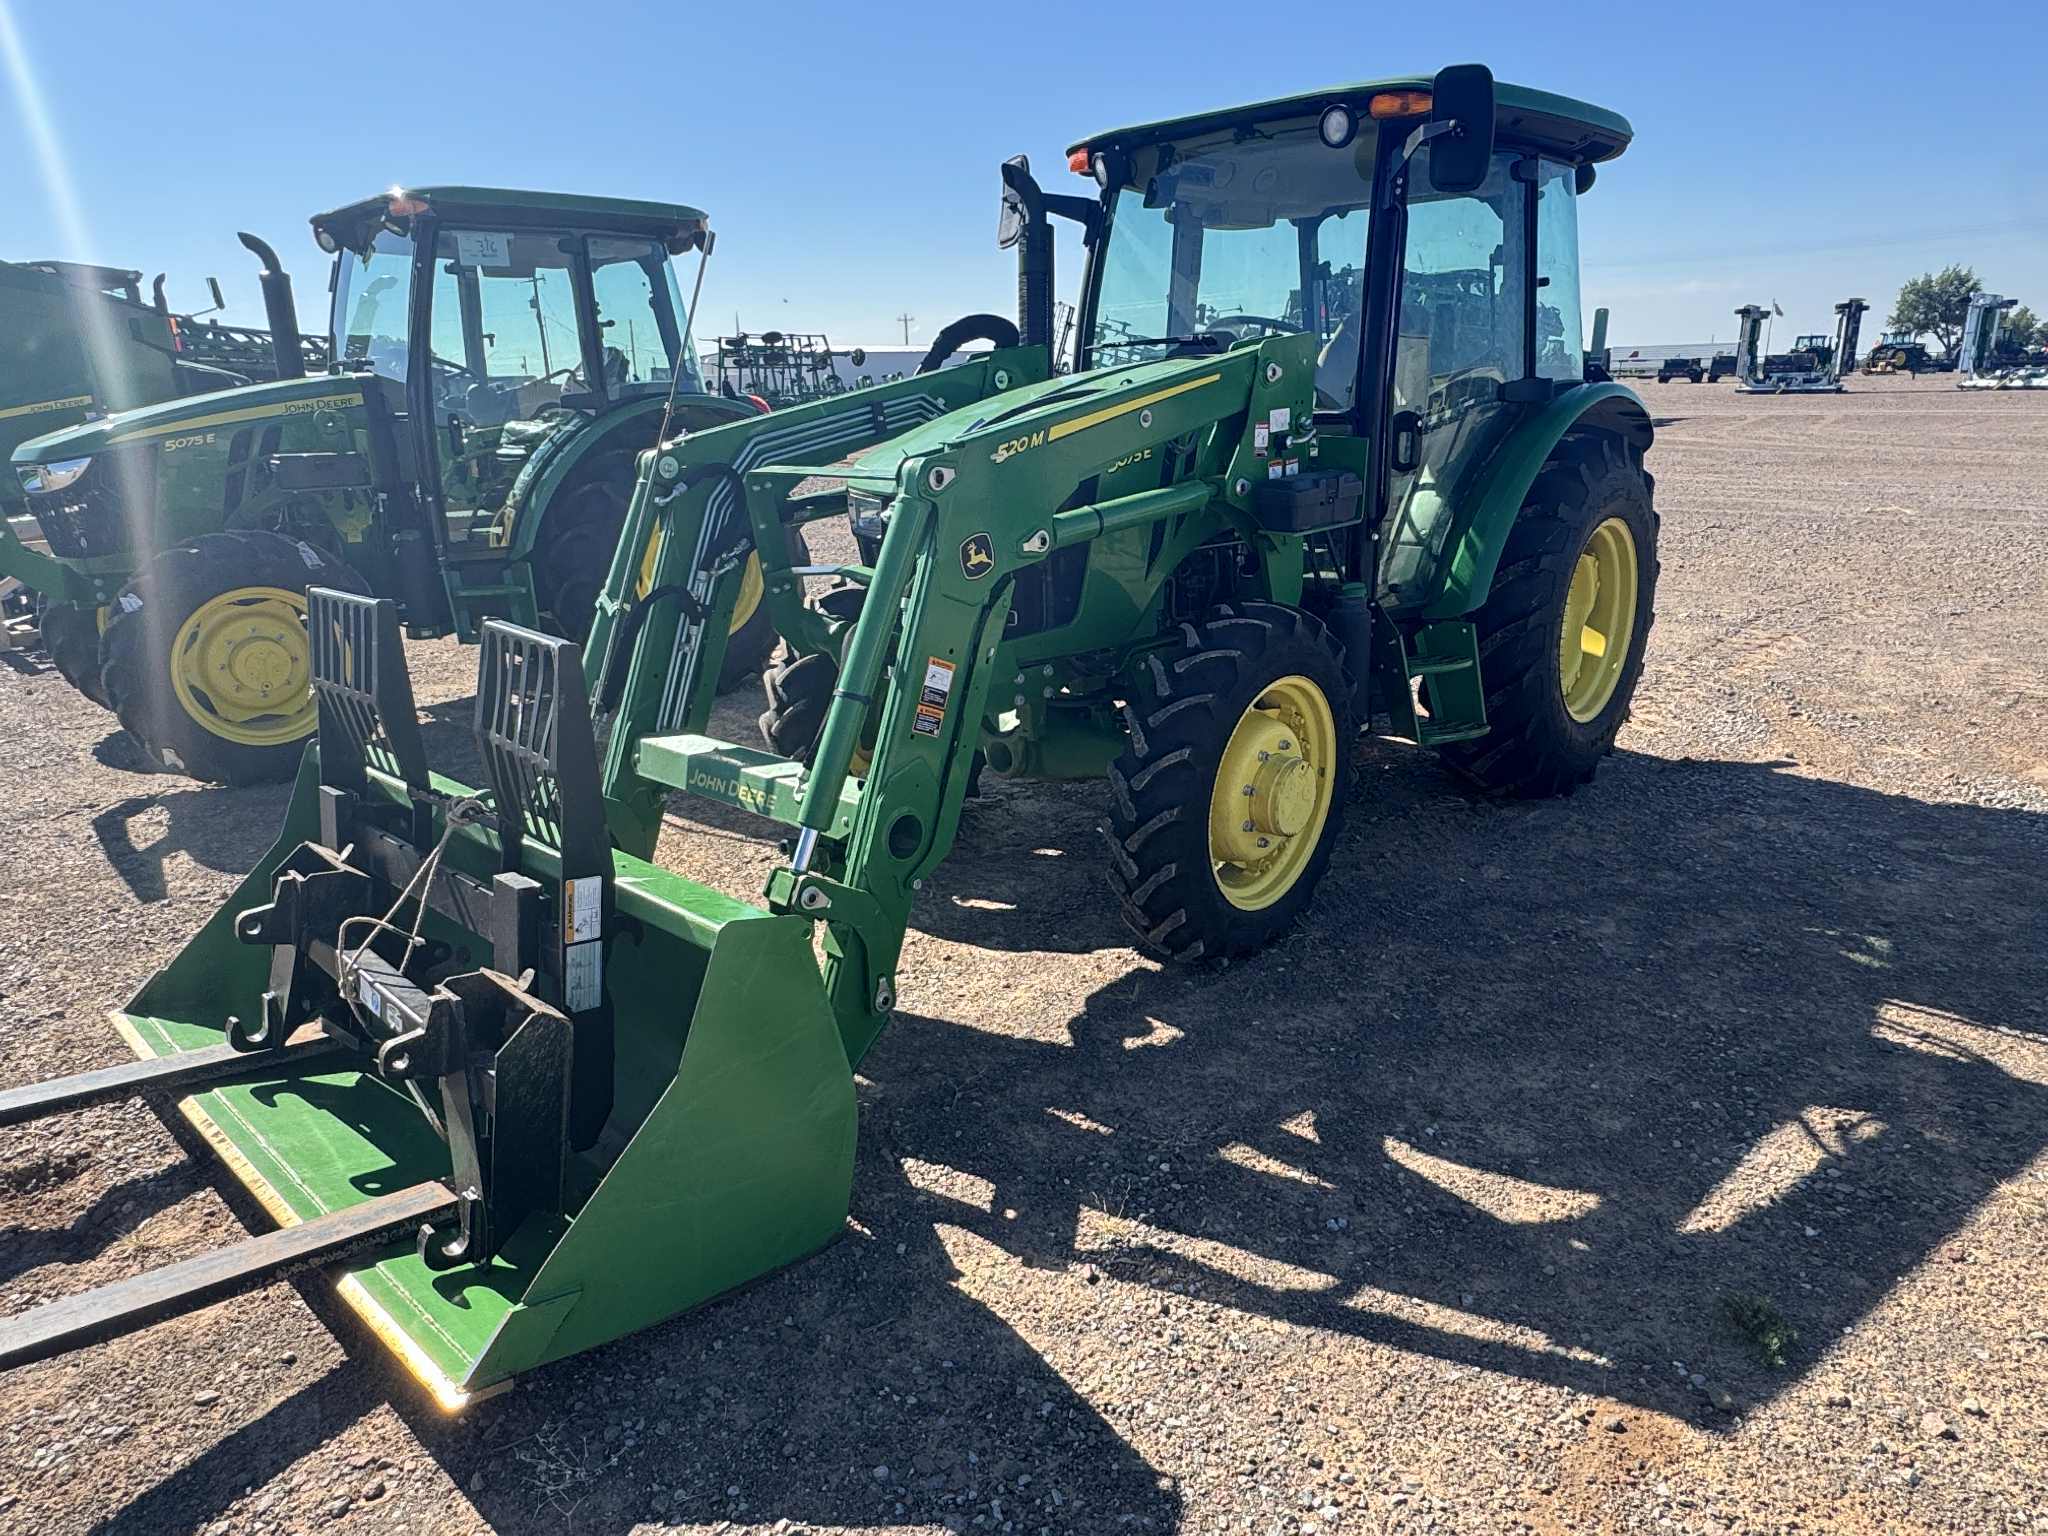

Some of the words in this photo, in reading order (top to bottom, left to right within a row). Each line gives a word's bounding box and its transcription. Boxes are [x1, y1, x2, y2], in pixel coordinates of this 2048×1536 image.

[282, 402, 314, 414] JOHN
[316, 398, 354, 410] DEERE
[165, 434, 204, 452] 5075
[995, 436, 1029, 463] 520
[1030, 430, 1045, 449] M
[689, 769, 725, 793] JOHN
[728, 780, 777, 809] DEERE
